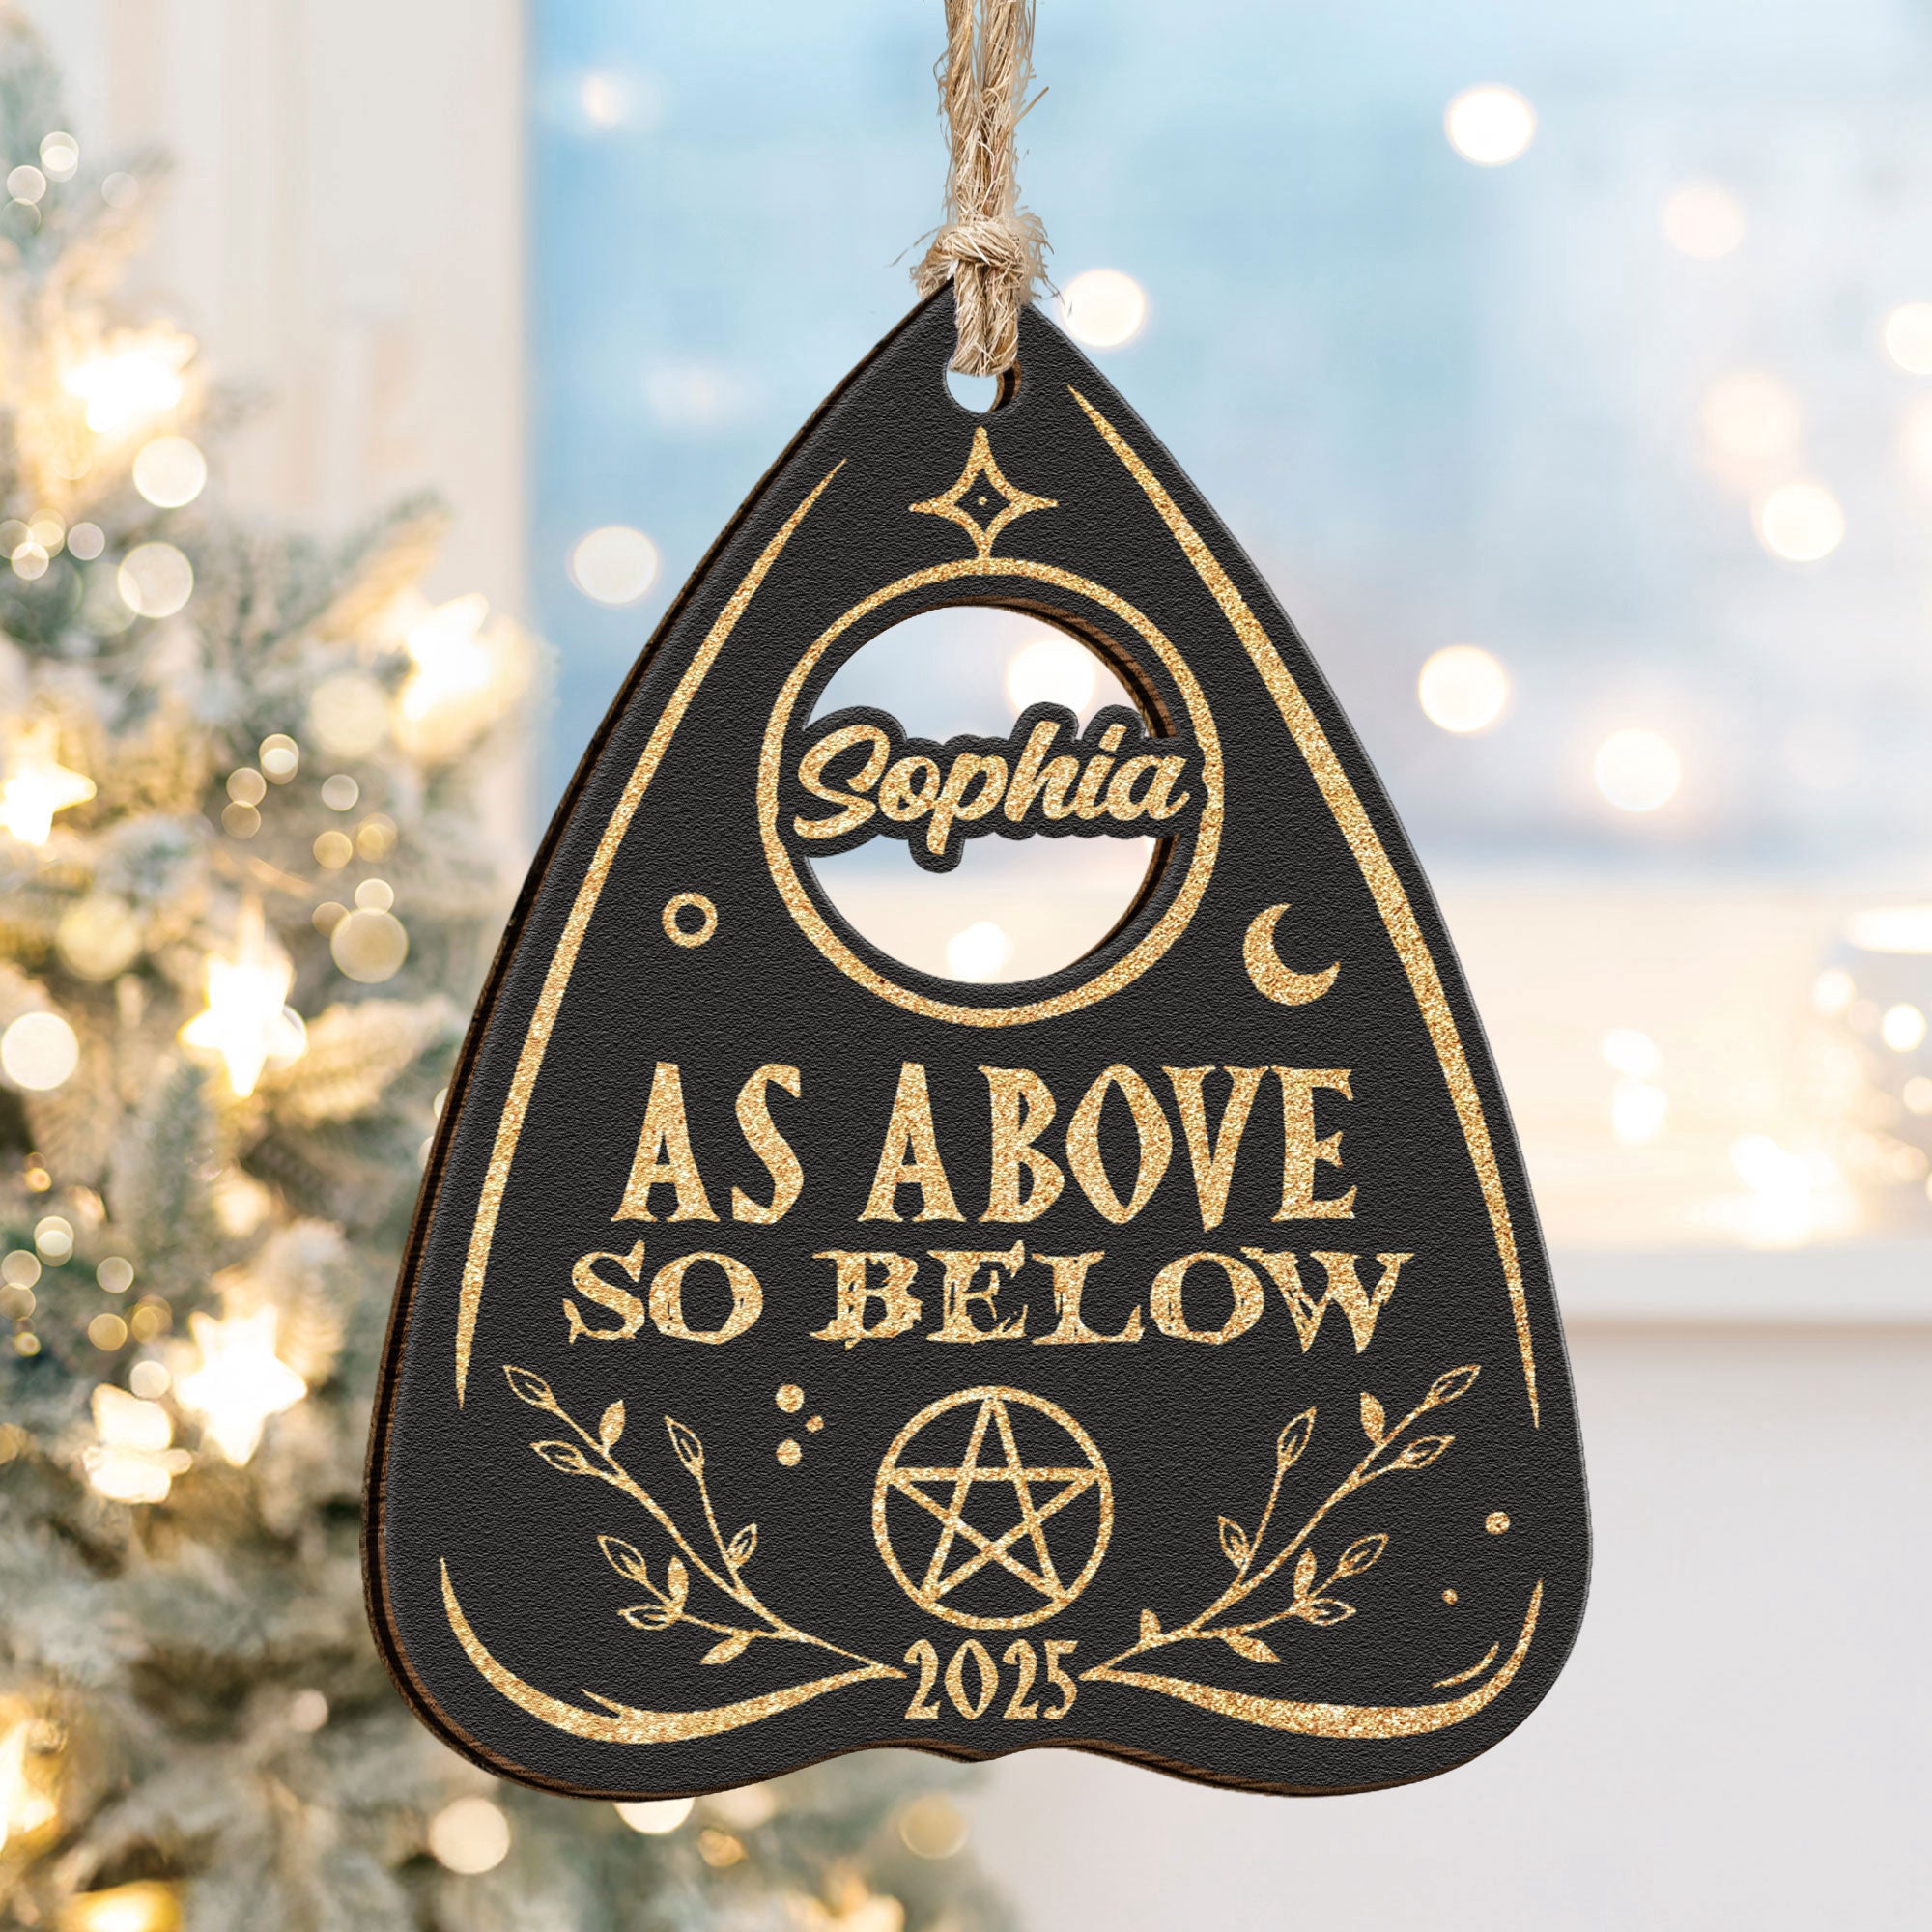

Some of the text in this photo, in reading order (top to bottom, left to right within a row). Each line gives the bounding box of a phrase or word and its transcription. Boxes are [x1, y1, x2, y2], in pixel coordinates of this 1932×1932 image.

[793, 721, 1190, 855] Sophia
[611, 1061, 1357, 1233] AS ABOVE
[562, 1240, 1414, 1353] SO BELOW
[903, 1639, 1078, 1720] 2025
